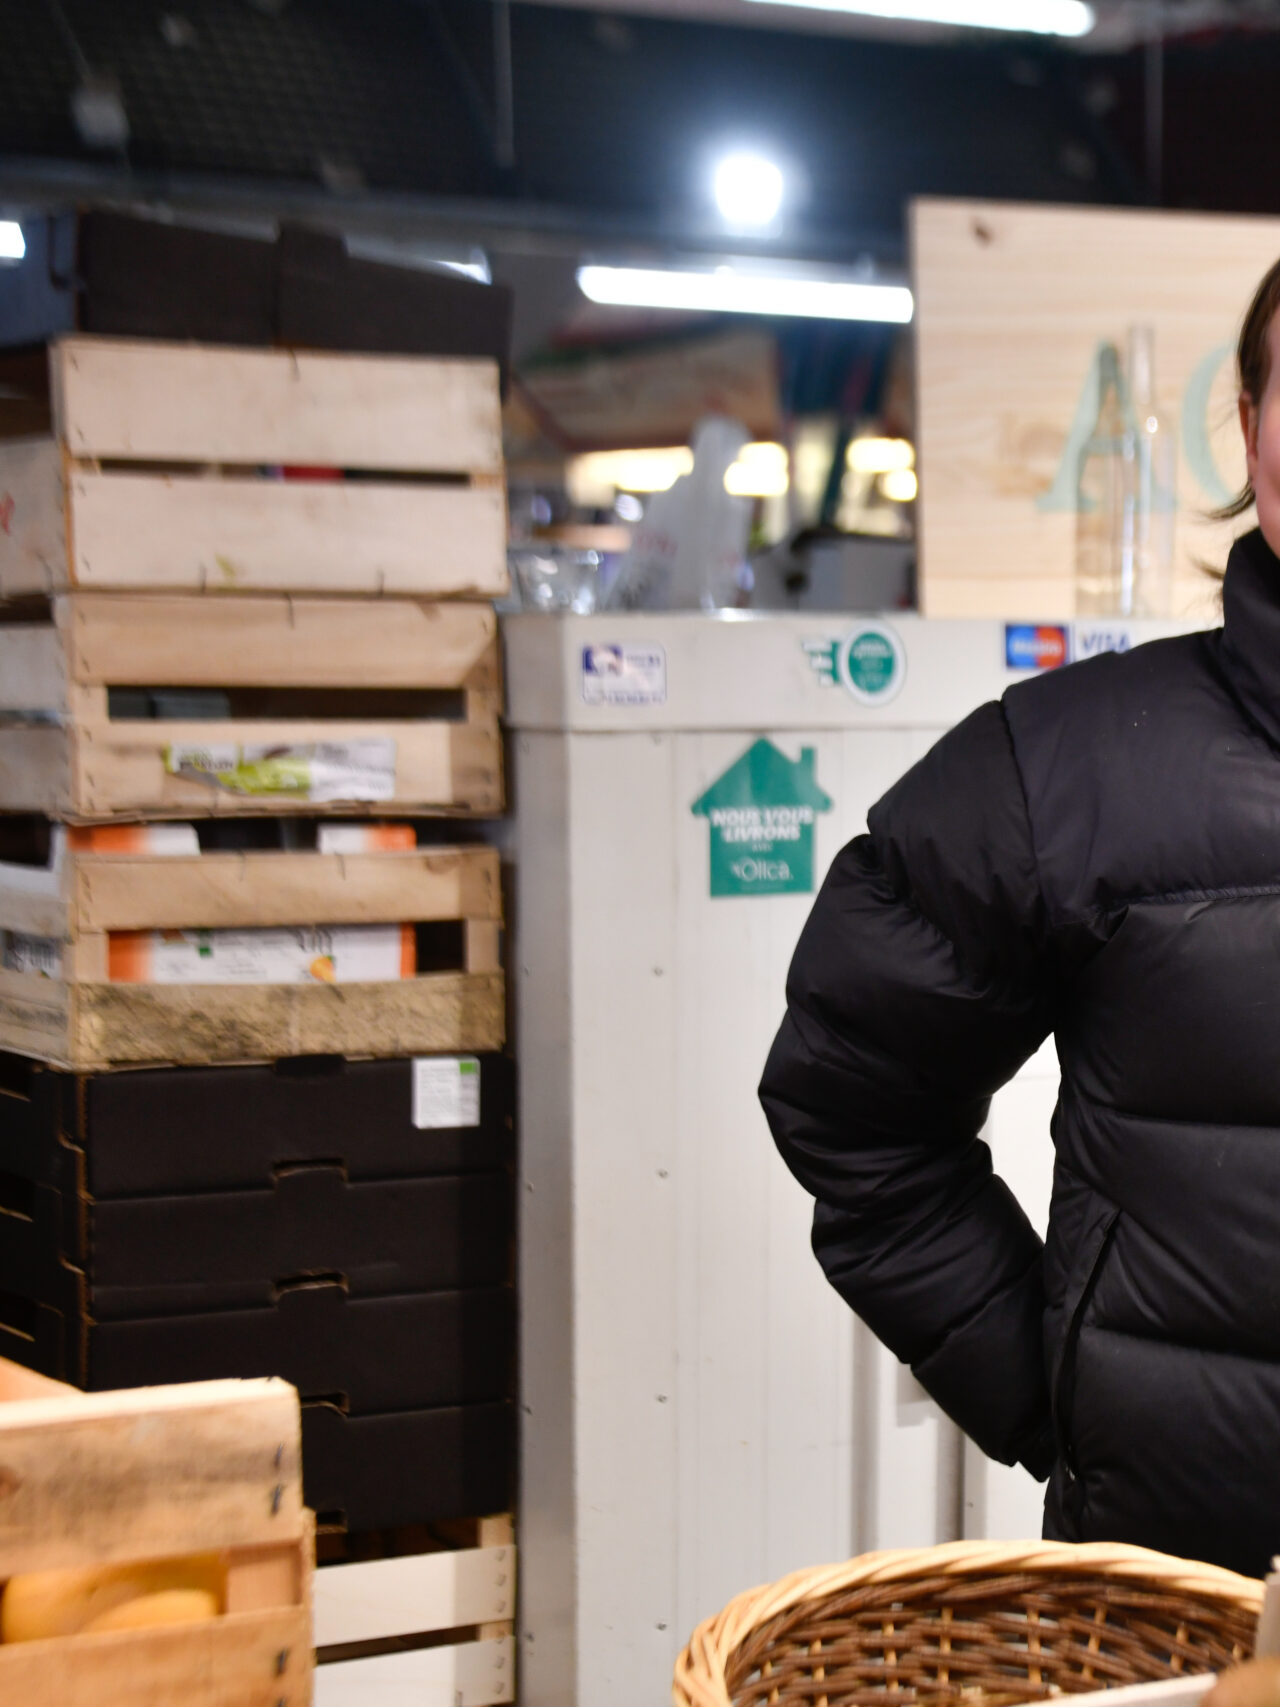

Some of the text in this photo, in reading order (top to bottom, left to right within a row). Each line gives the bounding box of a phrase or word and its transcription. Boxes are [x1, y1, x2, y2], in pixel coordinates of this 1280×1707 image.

[710, 805, 813, 827] NOUS VOUS
[722, 825, 801, 842] LIVRONS
